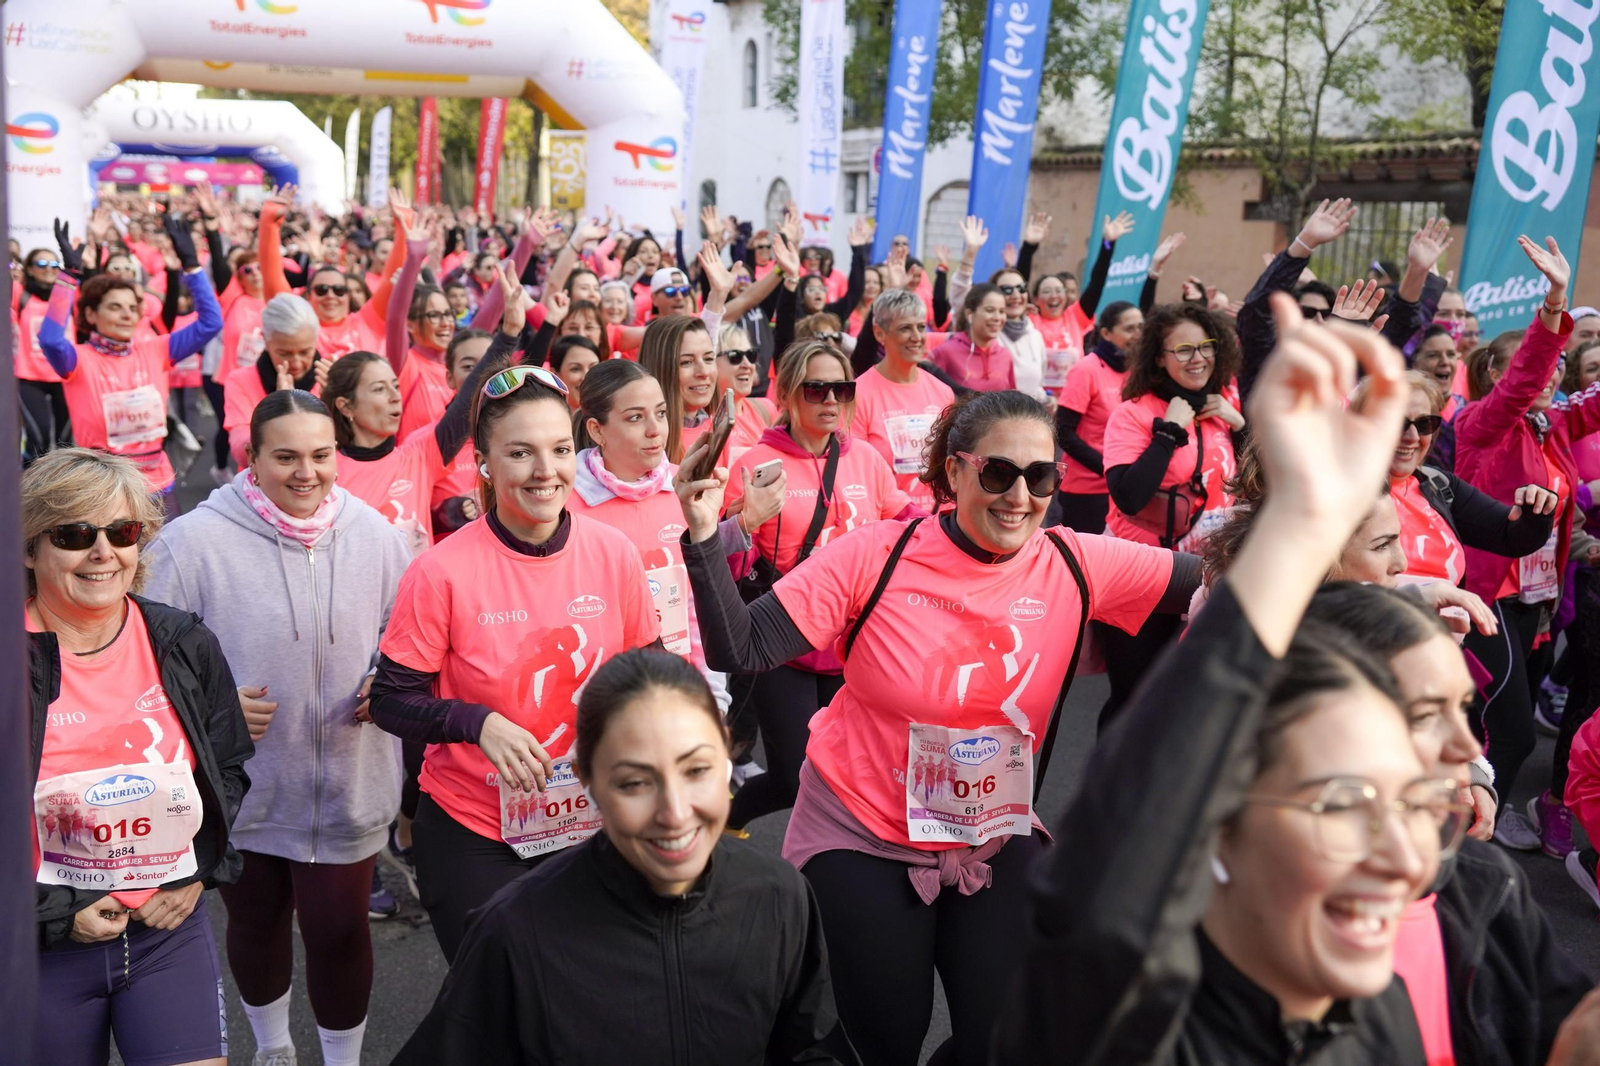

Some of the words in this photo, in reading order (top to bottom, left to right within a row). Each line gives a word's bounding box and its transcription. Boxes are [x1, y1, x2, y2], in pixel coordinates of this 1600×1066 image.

[209, 19, 307, 38] TotalEnergies
[405, 32, 494, 48] TotalEnergies
[981, 2, 1036, 165] Marlene
[886, 36, 930, 179] Marlene
[132, 105, 252, 132] OYSHO
[907, 593, 965, 614] OYSHO
[477, 609, 528, 625] OYSHO
[920, 744, 946, 755] SUMA
[90, 784, 150, 803] ASTURIANA
[953, 775, 996, 799] 016
[48, 797, 80, 806] SUMA
[545, 795, 589, 818] 016
[557, 816, 577, 827] 1109
[926, 810, 954, 822] CARRERA
[93, 817, 151, 843] 016
[520, 833, 547, 842] CARRERA
[556, 826, 564, 834] LA
[921, 824, 963, 836] OYSHO
[983, 820, 1015, 835] Santander
[108, 846, 135, 859] 2884
[516, 840, 555, 854] OYSHO
[63, 856, 94, 868] CARRERA
[107, 860, 117, 868] LA
[118, 857, 143, 867] MUJER
[149, 854, 178, 863] SEVILLA
[57, 868, 105, 883] OYSHO
